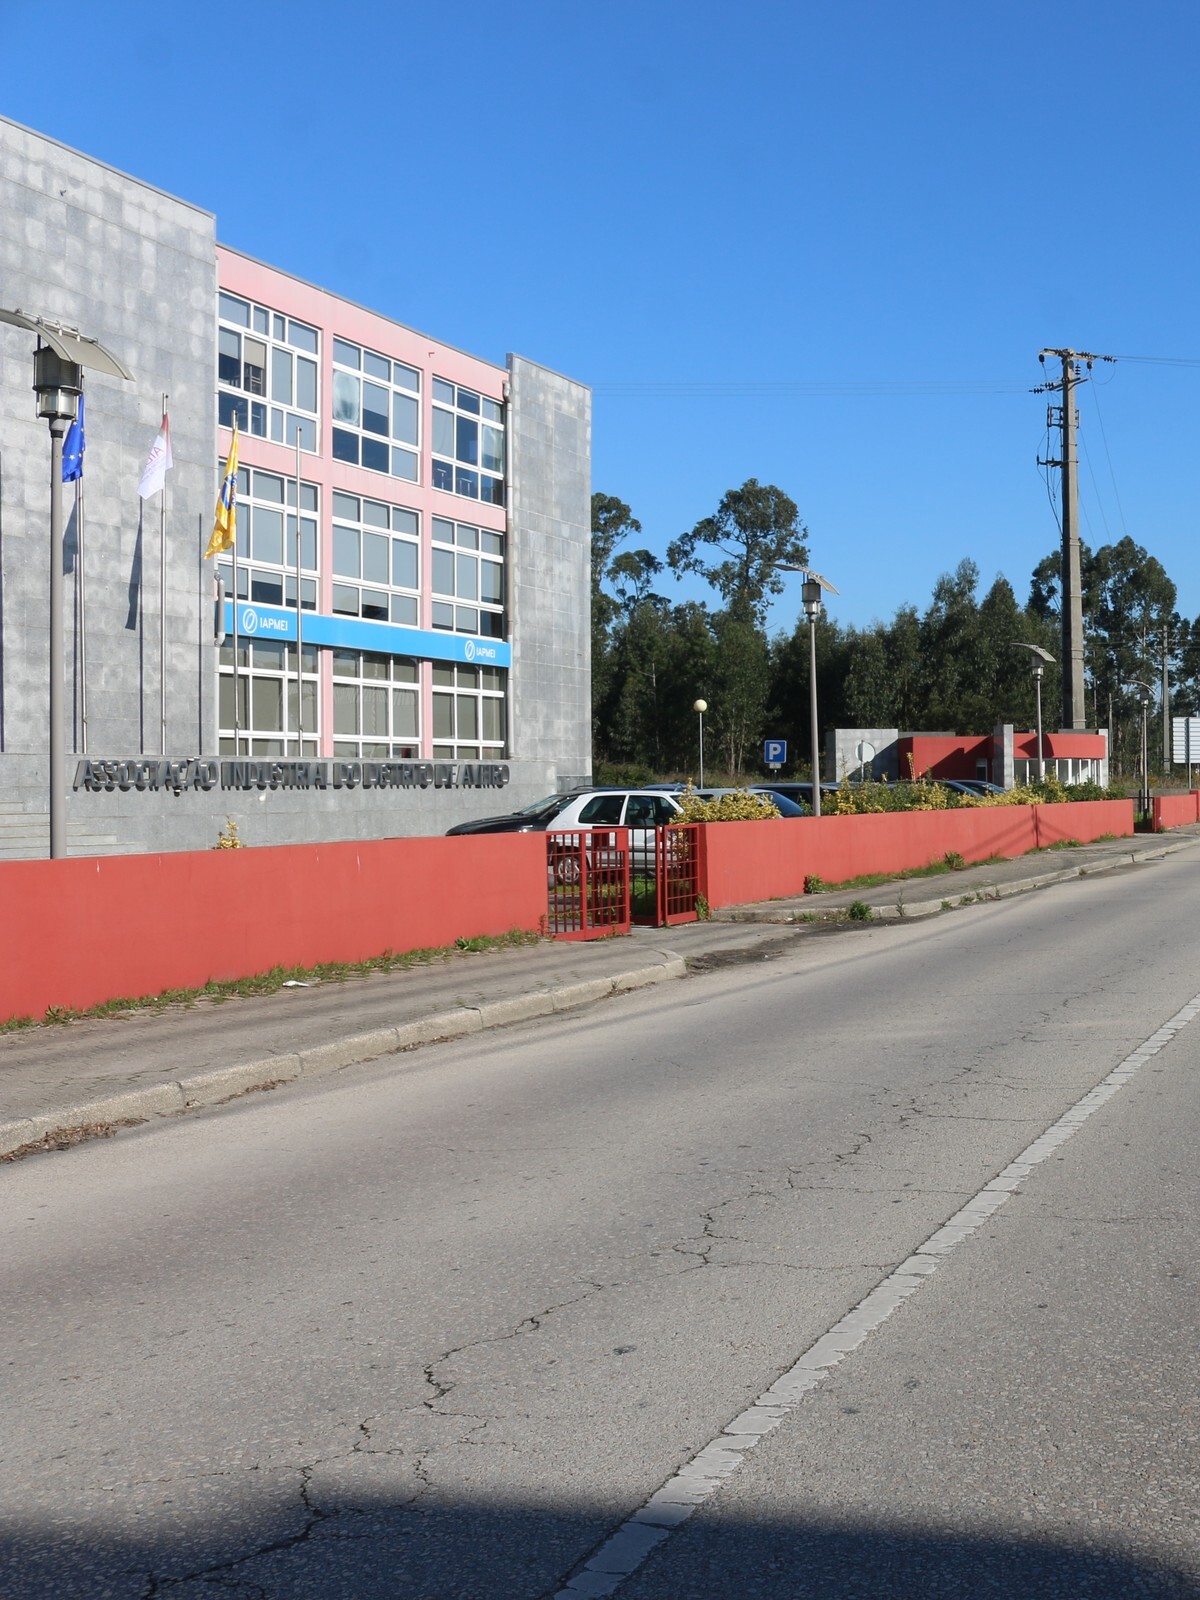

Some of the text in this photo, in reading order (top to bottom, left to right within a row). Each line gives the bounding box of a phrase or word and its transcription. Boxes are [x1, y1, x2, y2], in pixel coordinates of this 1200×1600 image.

[260, 617, 288, 631] IAPMEI
[476, 647, 496, 658] IAPMEI
[769, 743, 781, 760] P
[74, 757, 510, 795] ASSOCIAÇÃO INDUSTRIAL DO DISTRITO DE AVEIRO
